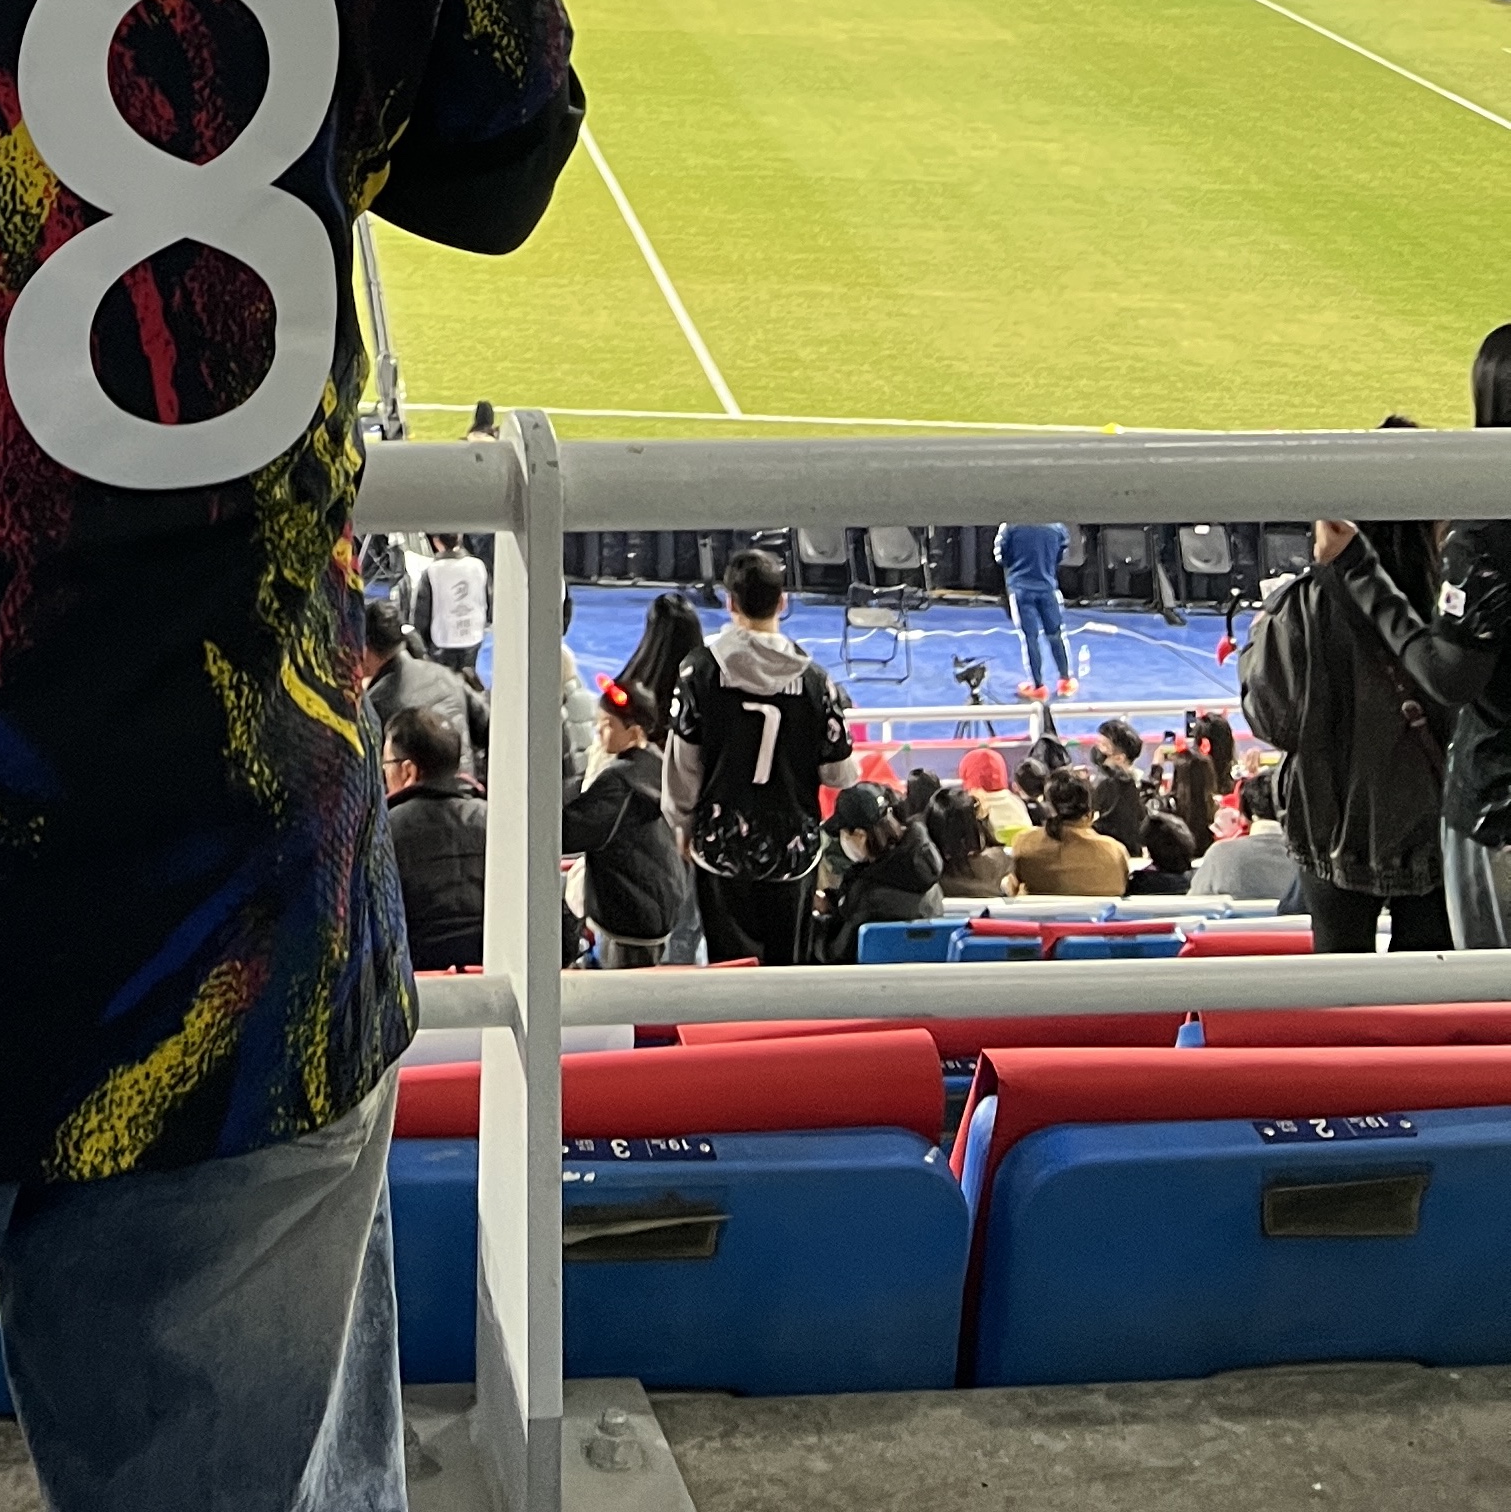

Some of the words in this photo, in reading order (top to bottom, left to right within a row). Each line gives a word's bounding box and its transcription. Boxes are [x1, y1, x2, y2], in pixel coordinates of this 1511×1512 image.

[741, 701, 781, 785] 7
[1309, 1118, 1335, 1138] 2
[610, 1138, 631, 1160] 3
